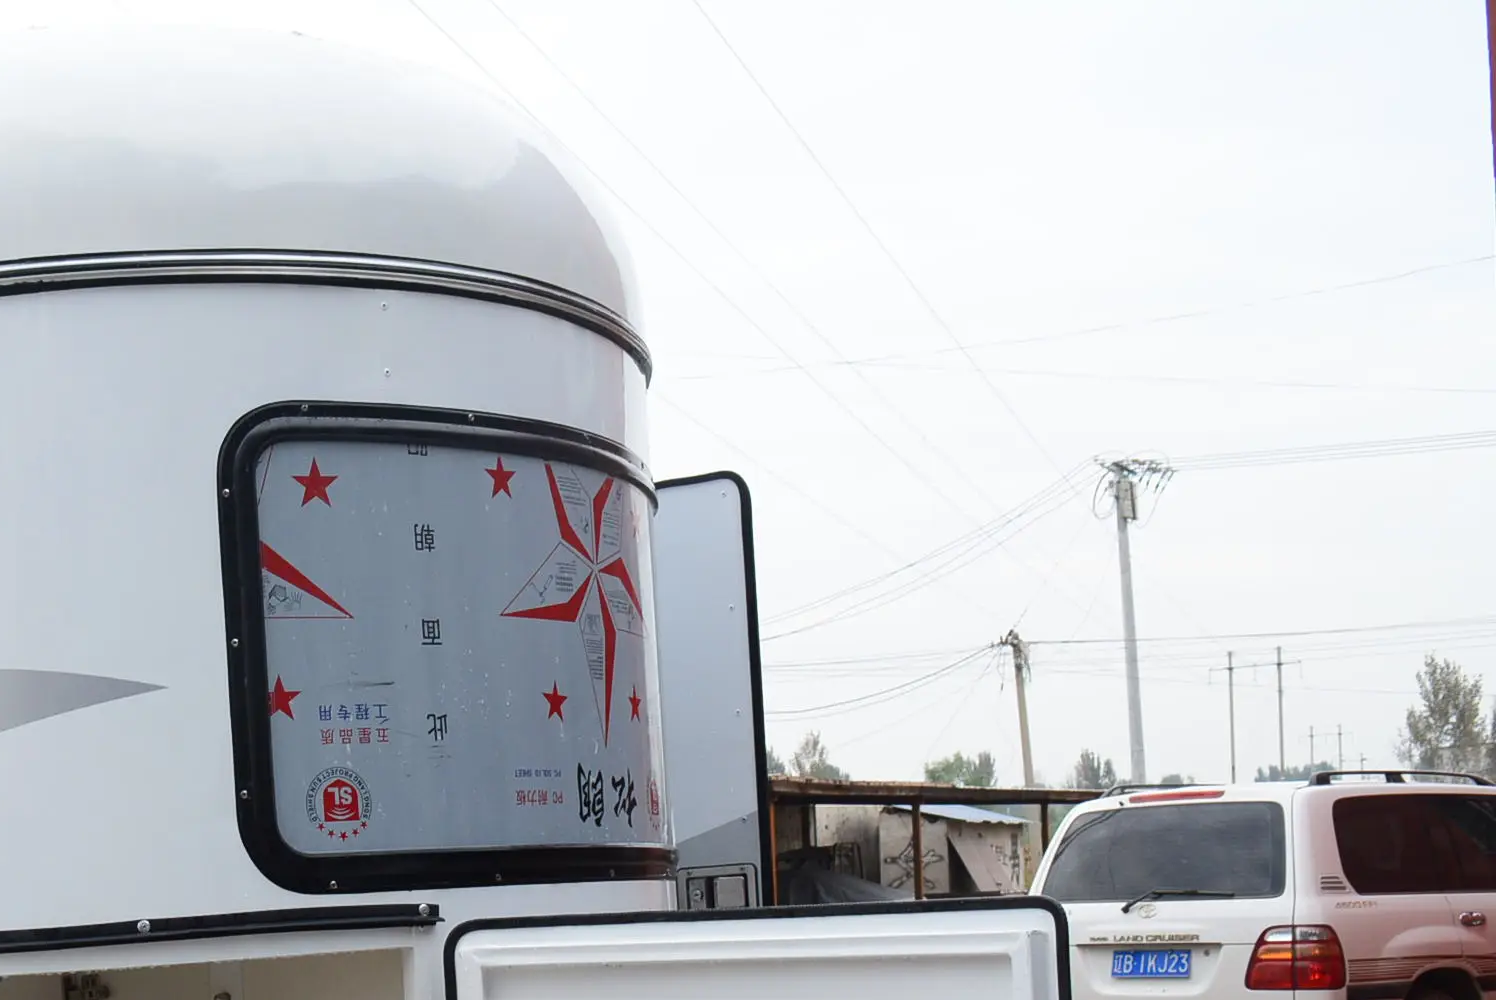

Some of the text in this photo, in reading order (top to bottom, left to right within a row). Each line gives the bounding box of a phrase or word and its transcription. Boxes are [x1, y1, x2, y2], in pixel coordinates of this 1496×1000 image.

[319, 703, 389, 721] 工程专用
[320, 727, 390, 745] 五星品质
[322, 767, 353, 780] PROJECT
[327, 785, 353, 805] SL
[515, 789, 564, 806] PC 耐力板
[1113, 934, 1144, 942] LAND
[1145, 934, 1200, 942] CRUISER
